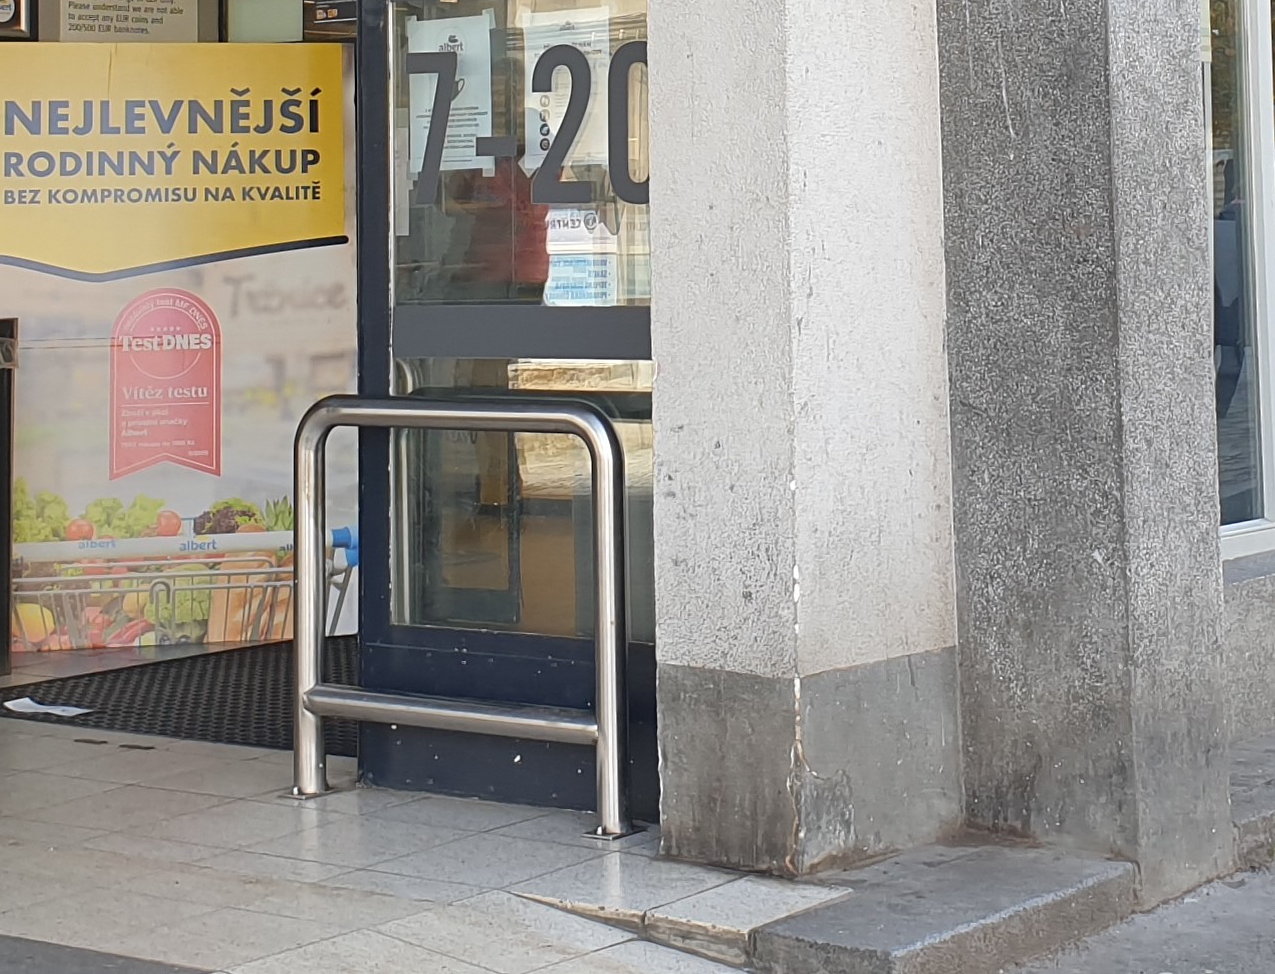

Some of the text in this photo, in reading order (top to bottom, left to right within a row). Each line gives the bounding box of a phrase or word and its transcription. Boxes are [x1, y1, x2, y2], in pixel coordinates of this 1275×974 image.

[438, 40, 464, 52] albert
[3, 86, 323, 137] NEJLEVNĚJŠÍ
[405, 39, 650, 206] 7-20
[3, 141, 321, 178] RODINNÝ NÁKUP
[3, 180, 321, 205] BEZ KOMPROMISU NA KVALITĚ
[122, 385, 208, 401] Vítěz testu
[77, 539, 117, 550] albert
[179, 538, 218, 552] albert
